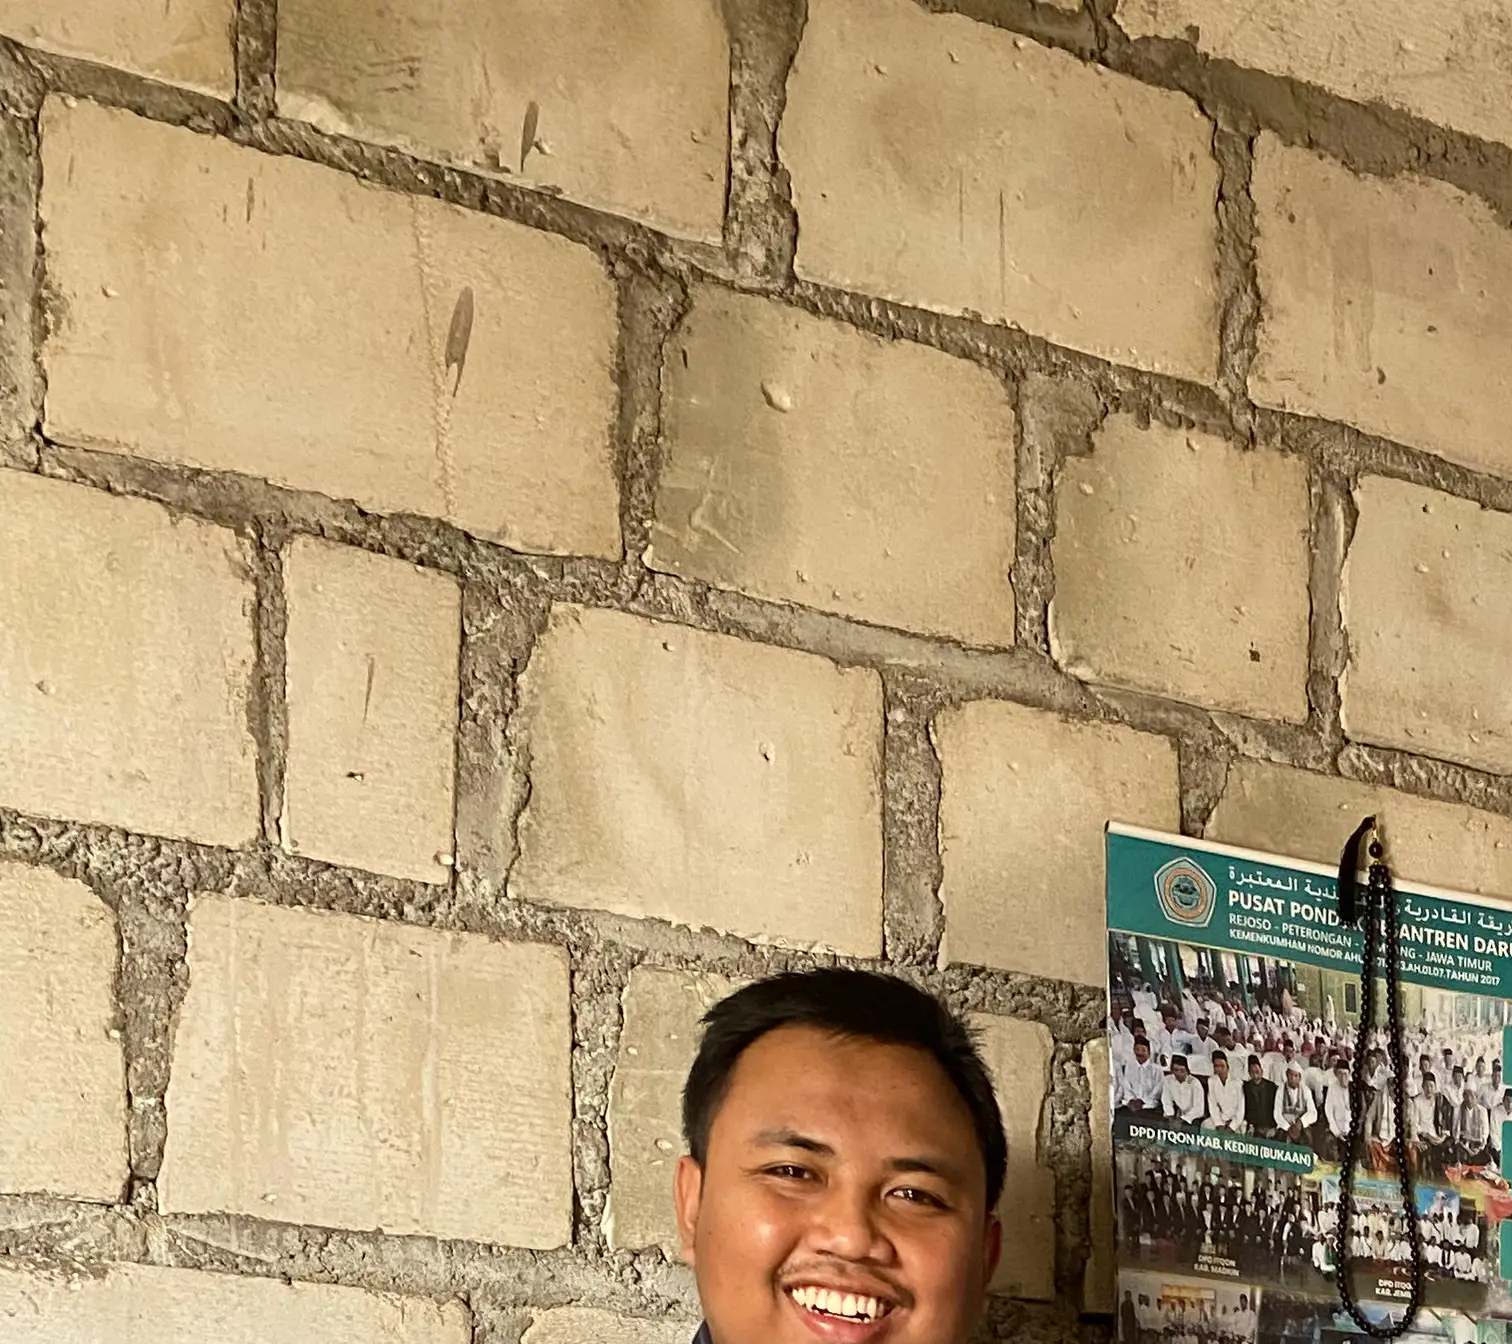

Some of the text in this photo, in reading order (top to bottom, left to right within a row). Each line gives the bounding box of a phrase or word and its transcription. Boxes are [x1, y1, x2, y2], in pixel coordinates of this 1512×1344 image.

[1229, 866, 1298, 892] المعتبرة
[1229, 890, 1286, 916] PUSAT
[1404, 899, 1471, 925] القادرية
[1229, 913, 1272, 931] REJOSO
[1282, 922, 1352, 948] PETERONGAN
[1426, 951, 1455, 966] JAWA
[1457, 956, 1492, 971] TIMUR
[1229, 928, 1306, 952] KEMENKUMHAM
[1308, 944, 1343, 960] NOMOR
[1480, 974, 1500, 987] 2017
[1130, 1125, 1154, 1139] DPD
[1157, 1129, 1195, 1145] ITQON
[1224, 1140, 1259, 1156] KEDIRI
[1260, 1146, 1311, 1167] (BUKAAN)
[1394, 1280, 1413, 1290] ITQO
